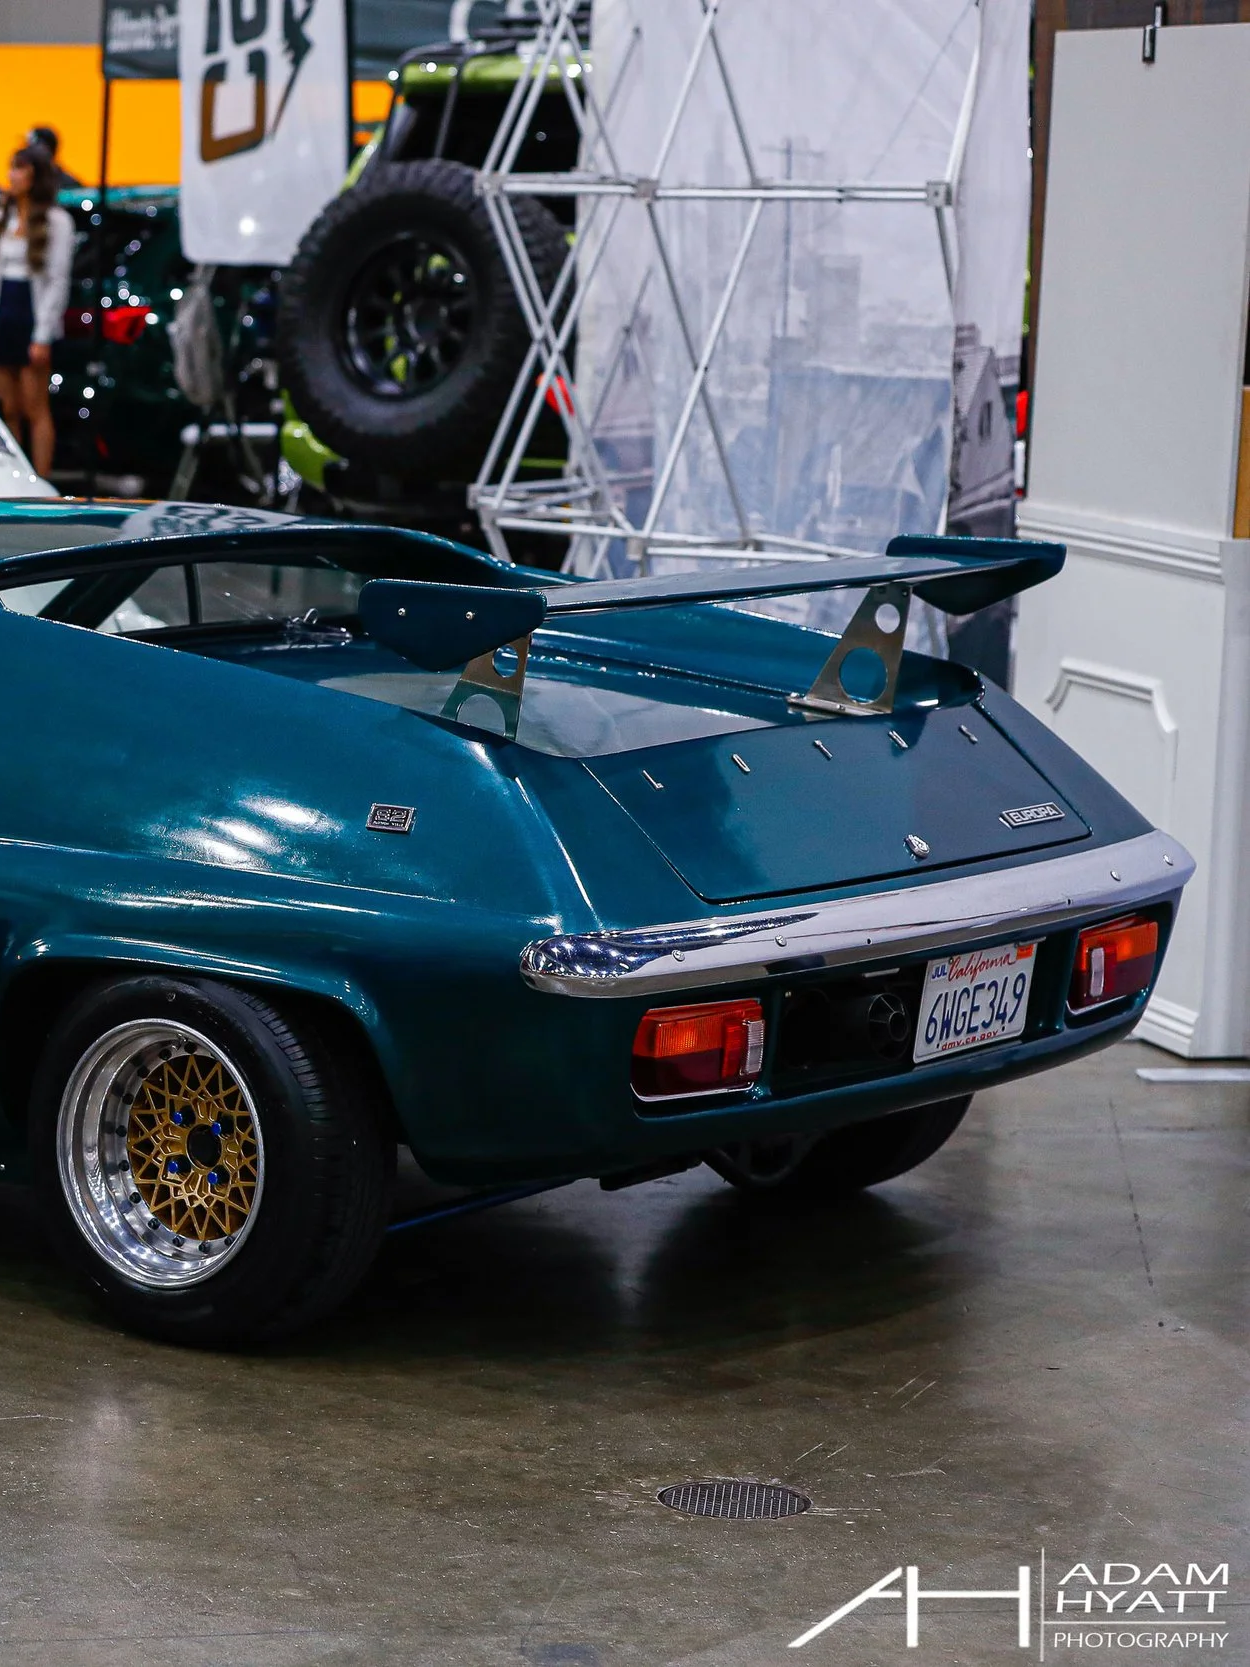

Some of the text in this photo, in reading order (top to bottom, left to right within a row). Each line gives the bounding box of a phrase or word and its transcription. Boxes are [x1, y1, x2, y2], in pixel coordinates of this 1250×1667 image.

[1009, 805, 1059, 823] EUROPA
[932, 964, 948, 980] JUL
[948, 952, 1018, 983] California
[924, 972, 1027, 1045] 6WGE349
[941, 1030, 999, 1051] dmv.ca.gov
